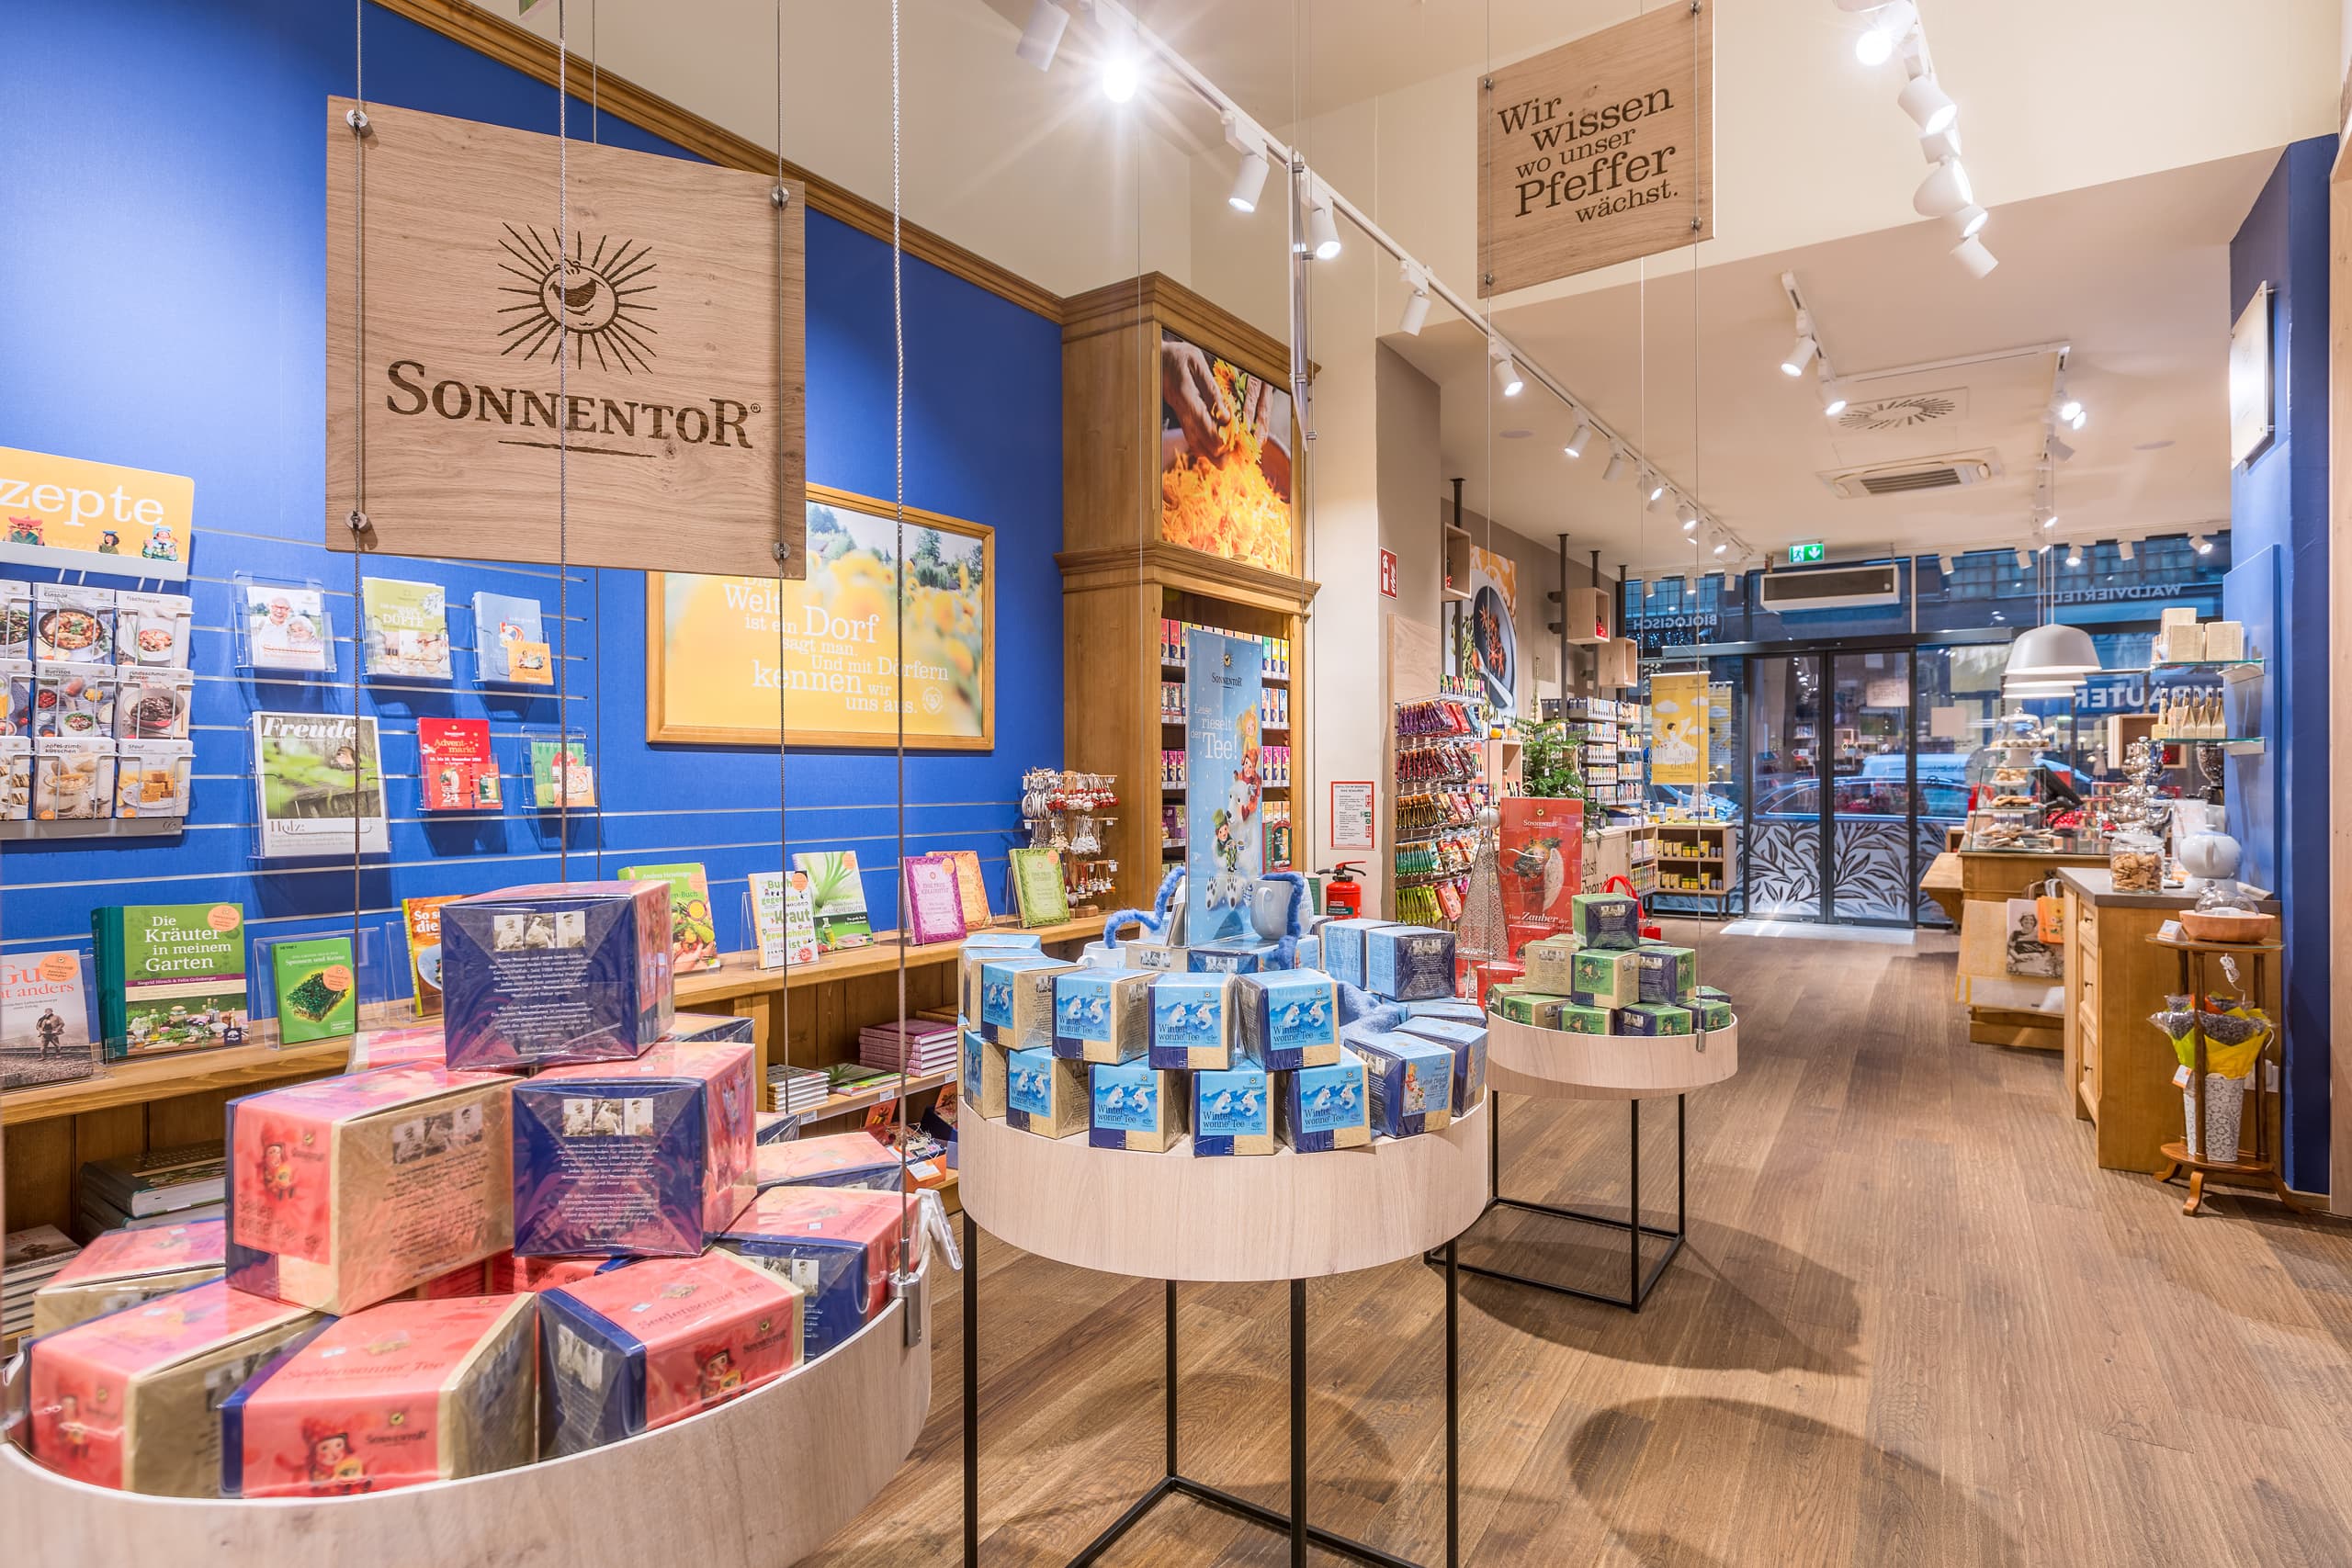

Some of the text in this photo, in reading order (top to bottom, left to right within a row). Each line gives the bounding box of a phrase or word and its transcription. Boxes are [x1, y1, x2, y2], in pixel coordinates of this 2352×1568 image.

[1498, 97, 1561, 134] Wir
[1531, 88, 1674, 152] wissen
[1515, 129, 1636, 179] wo unser
[1515, 146, 1676, 218] Pfeffer
[1575, 179, 1678, 222] wächst.
[723, 584, 782, 616] Welt
[745, 613, 767, 631] ist
[804, 605, 879, 643] Dorf
[782, 637, 858, 657] sagt man.
[812, 654, 843, 672] Und
[848, 661, 873, 673] mit
[752, 660, 863, 694] kennen
[867, 683, 892, 696] wir
[845, 696, 878, 711] uns
[263, 716, 356, 739] Freude
[1201, 716, 1231, 730] rieselt
[1202, 731, 1238, 761] Tee!
[153, 916, 176, 927] Die
[413, 910, 430, 920] So
[1521, 911, 1558, 923] Zauber
[416, 919, 438, 932] die
[144, 928, 220, 943] Kräuter
[153, 943, 232, 956] in meinem
[145, 957, 214, 972] Garten
[17, 984, 74, 998] anders
[413, 1360, 446, 1370] Tee
